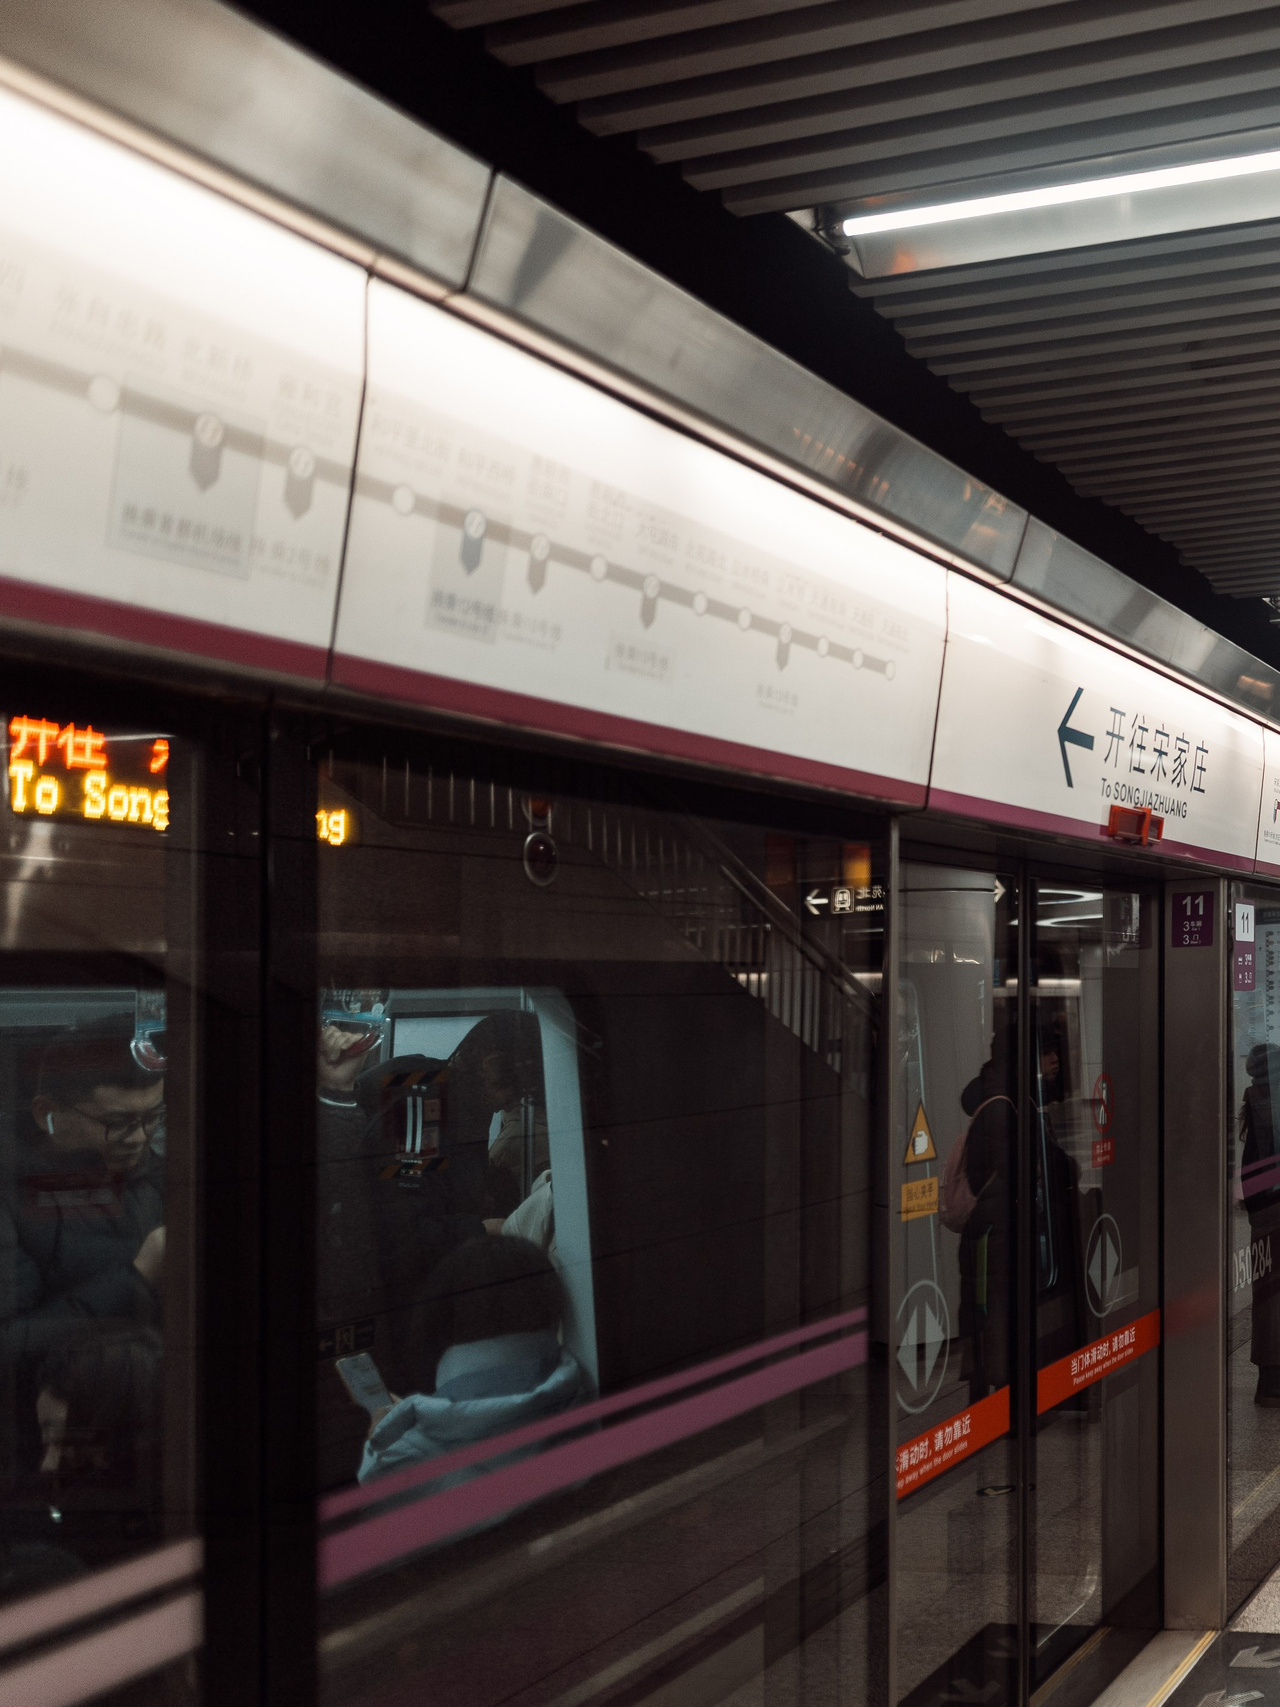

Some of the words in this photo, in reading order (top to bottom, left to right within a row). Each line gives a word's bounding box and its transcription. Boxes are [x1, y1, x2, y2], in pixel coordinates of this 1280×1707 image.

[1104, 707, 1209, 794] 开往宋家庄
[10, 759, 58, 814] To
[1101, 778, 1112, 798] To
[1114, 782, 1188, 818] SONGJIAZHUANG
[1182, 895, 1204, 916] 11
[1183, 921, 1190, 932] 3
[1241, 912, 1249, 934] 11
[1183, 934, 1190, 945] 3
[942, 1449, 954, 1462] door
